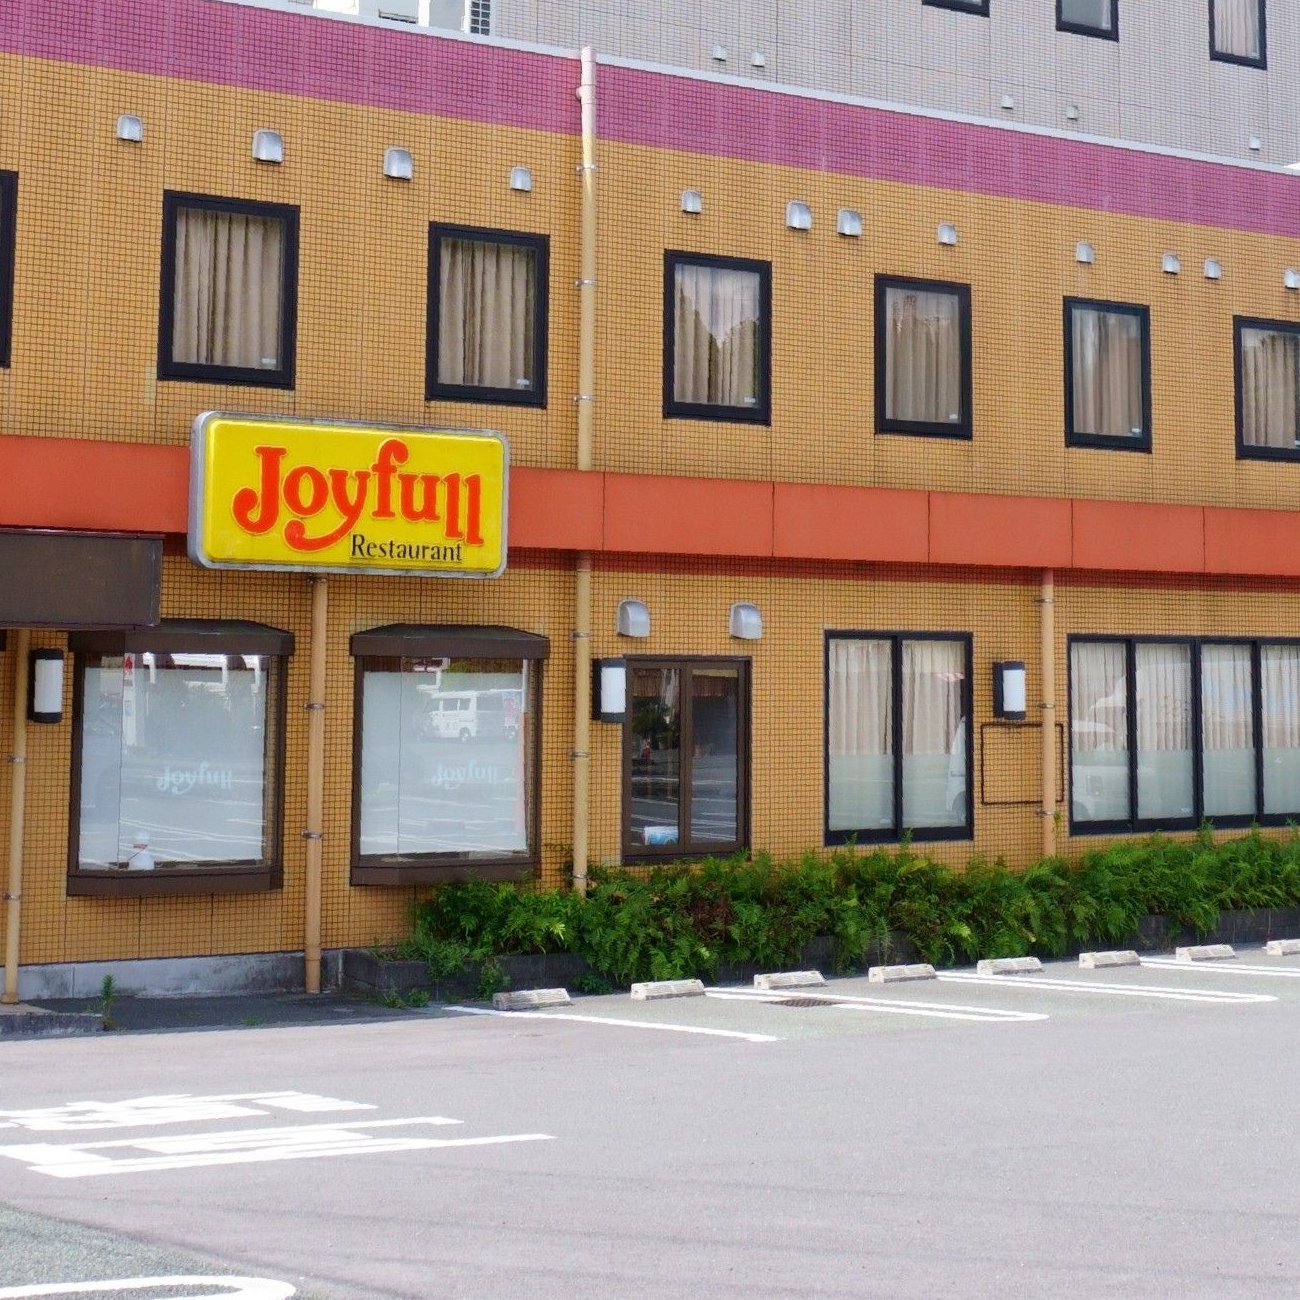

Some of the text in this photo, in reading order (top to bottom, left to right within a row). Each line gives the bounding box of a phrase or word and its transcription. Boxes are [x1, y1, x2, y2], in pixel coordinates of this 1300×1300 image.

[232, 438, 485, 552] Joyfull
[350, 532, 464, 563] Restaurant
[156, 761, 233, 796] Joyfull
